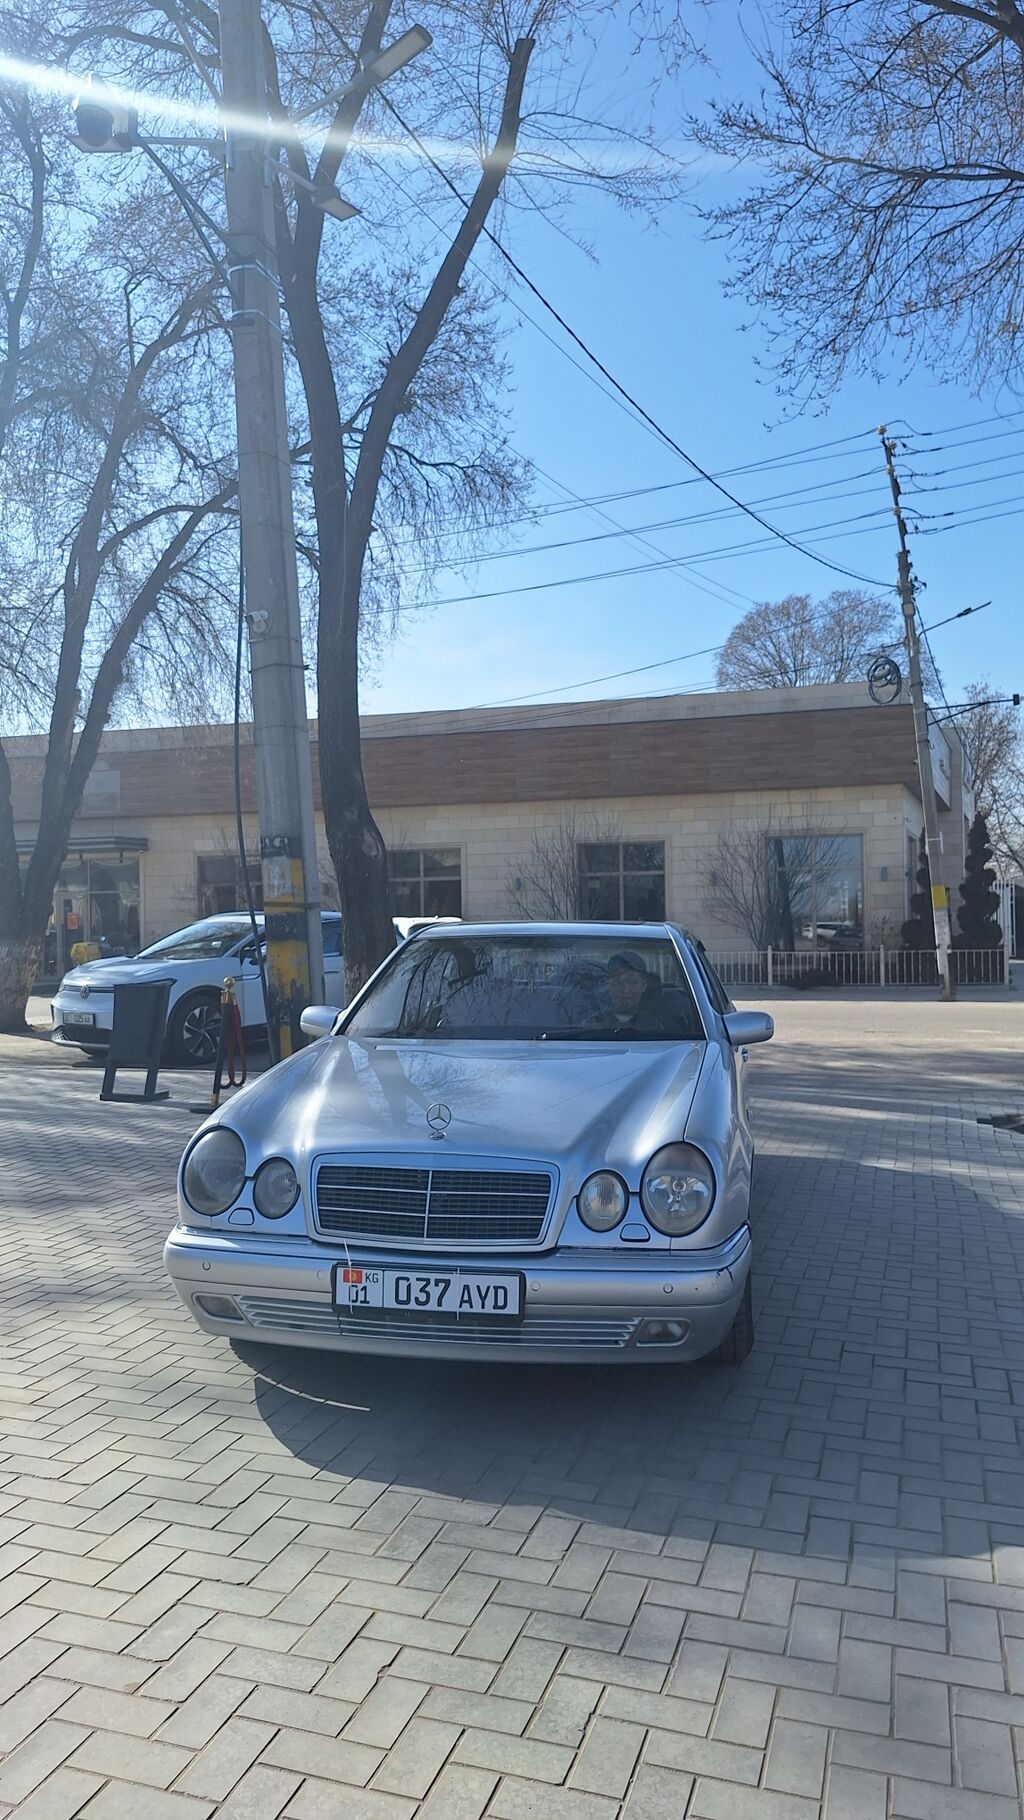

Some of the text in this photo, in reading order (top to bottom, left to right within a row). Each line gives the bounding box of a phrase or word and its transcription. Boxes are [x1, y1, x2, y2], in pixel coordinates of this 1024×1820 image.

[365, 1272, 379, 1284] KG
[348, 1276, 508, 1310] 01 037 AYD
